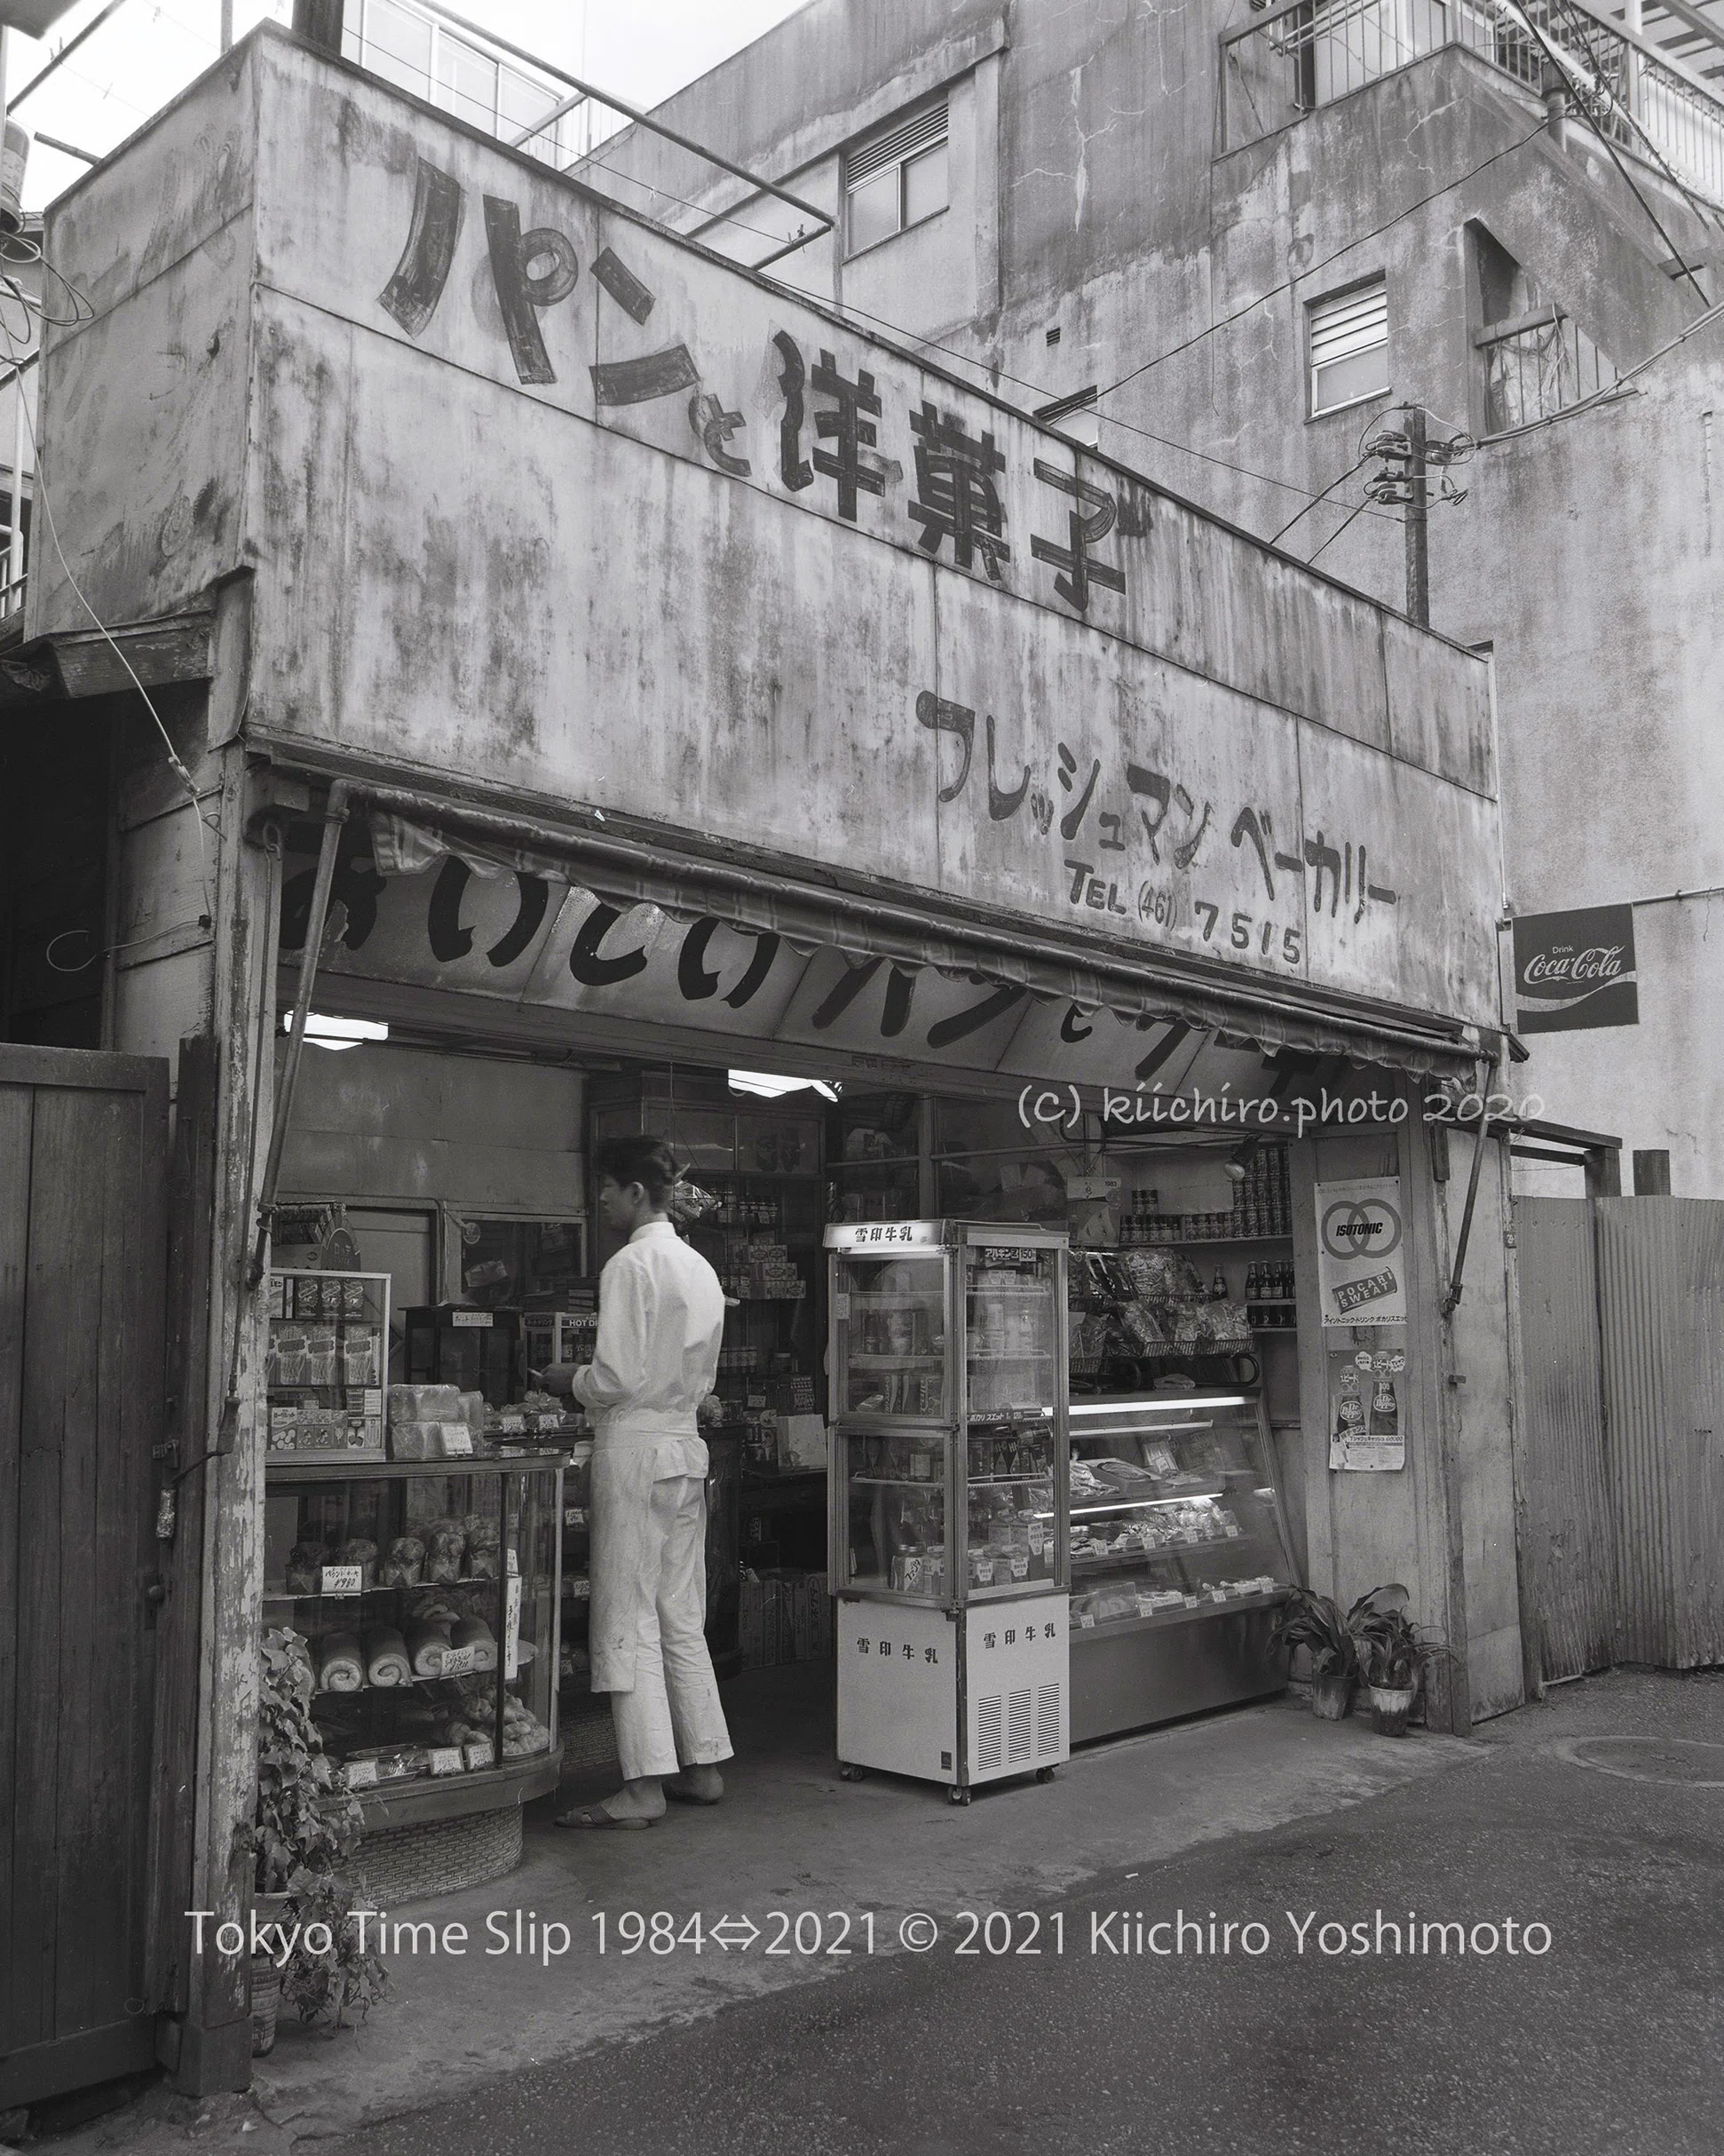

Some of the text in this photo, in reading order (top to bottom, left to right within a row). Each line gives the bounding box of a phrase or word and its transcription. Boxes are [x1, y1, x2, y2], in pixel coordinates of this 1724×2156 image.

[377, 157, 1127, 613] パンと洋菓子
[1064, 859, 1301, 965] TEL (461) 7515
[1552, 945, 1574, 955] Drink
[1523, 944, 1626, 985] Coca-Cola
[854, 1225, 913, 1243] 雪印牛乳
[1335, 1221, 1384, 1238] ISOTONIC
[1338, 1270, 1394, 1299] POCARI
[1340, 1281, 1389, 1308] SWEAT
[904, 1558, 922, 1581] ファンタ
[984, 1622, 1056, 1650] 雪印牛乳
[856, 1637, 939, 1665] 雪印牛乳
